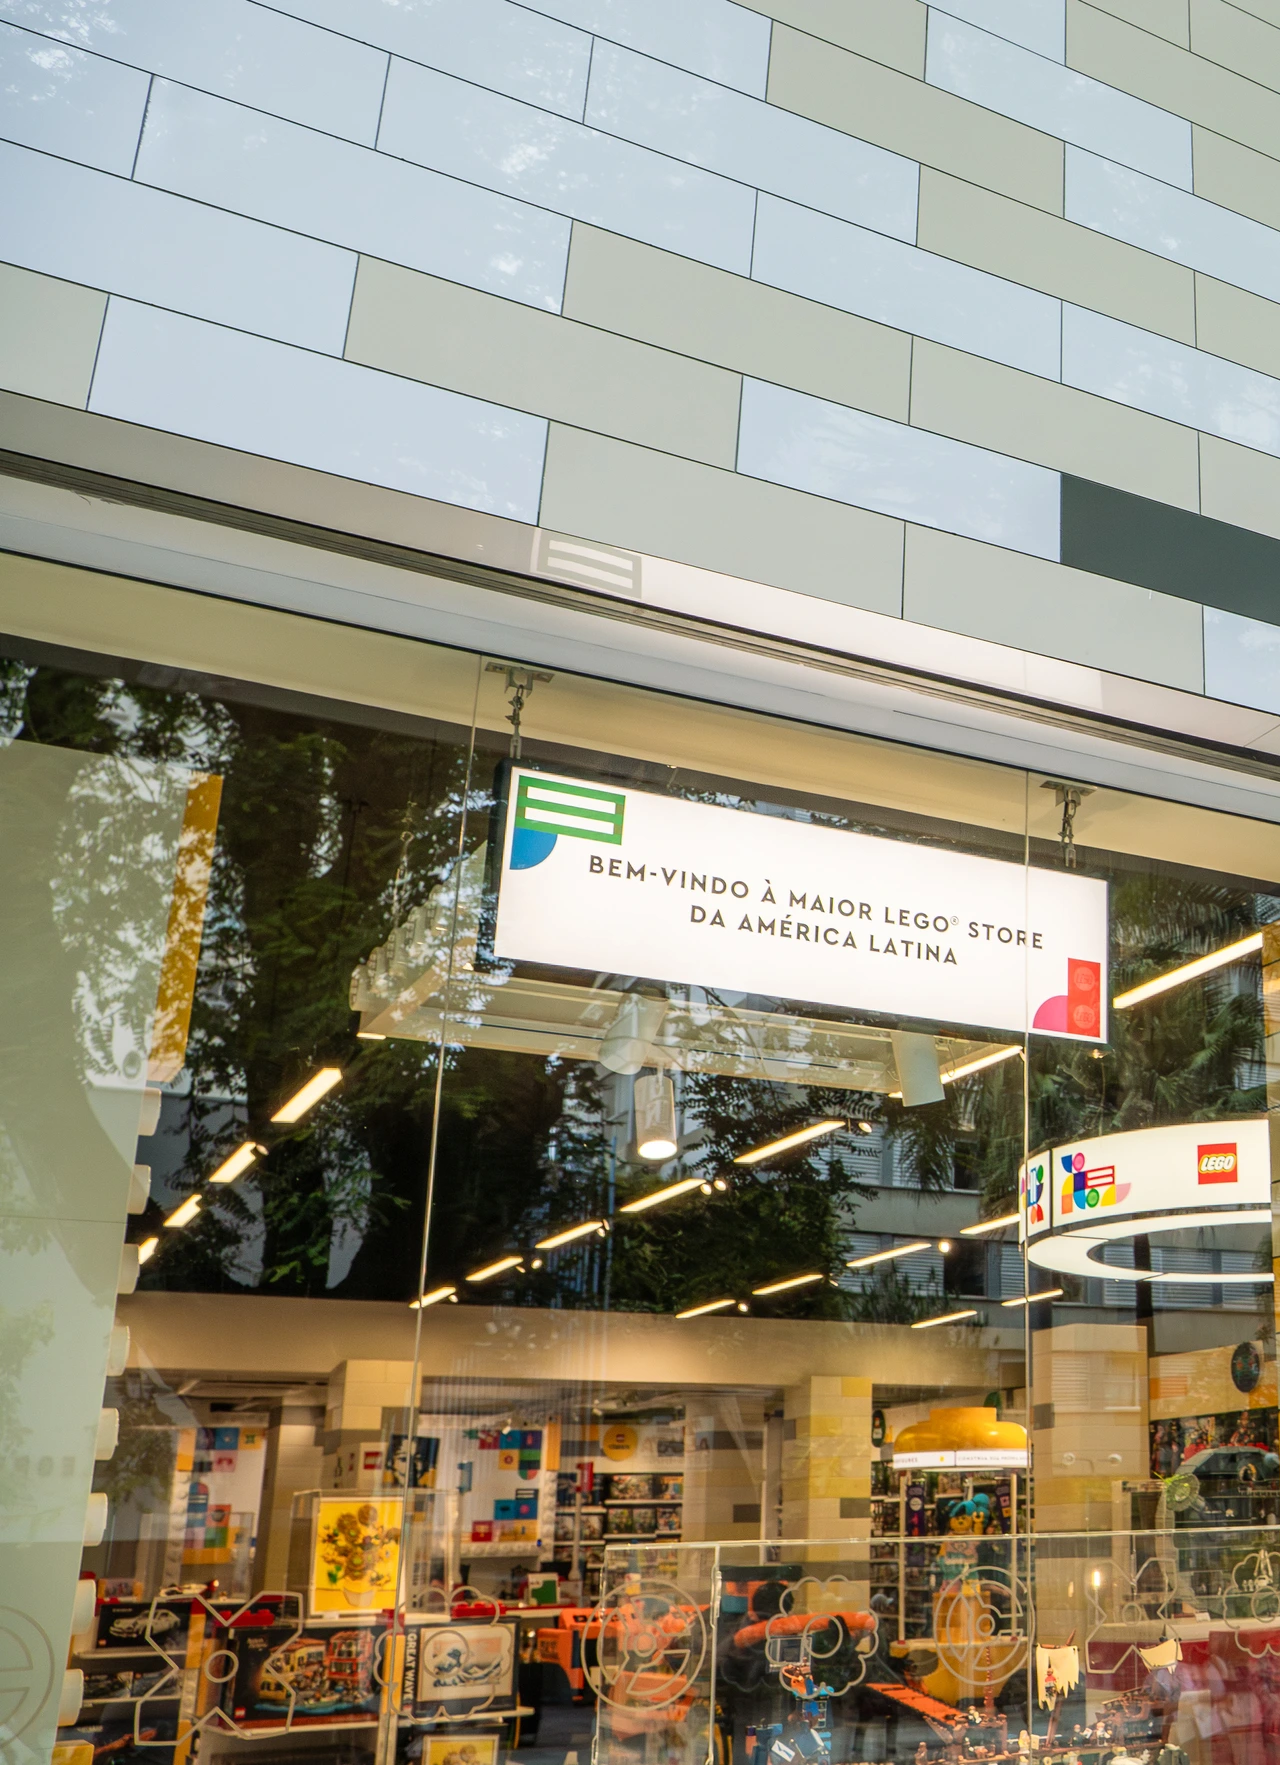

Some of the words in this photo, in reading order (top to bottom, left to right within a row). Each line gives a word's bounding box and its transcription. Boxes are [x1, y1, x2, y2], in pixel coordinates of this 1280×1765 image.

[589, 854, 749, 899] BEM-VINDO
[760, 878, 777, 905] À
[789, 889, 873, 921] MAIOR
[968, 921, 1044, 950] STORE
[690, 905, 726, 928] DA
[738, 914, 858, 949] AMÉRICA
[869, 934, 958, 965] LATINA
[1200, 1154, 1235, 1173] LEGO
[405, 1633, 418, 1669] GREAT
